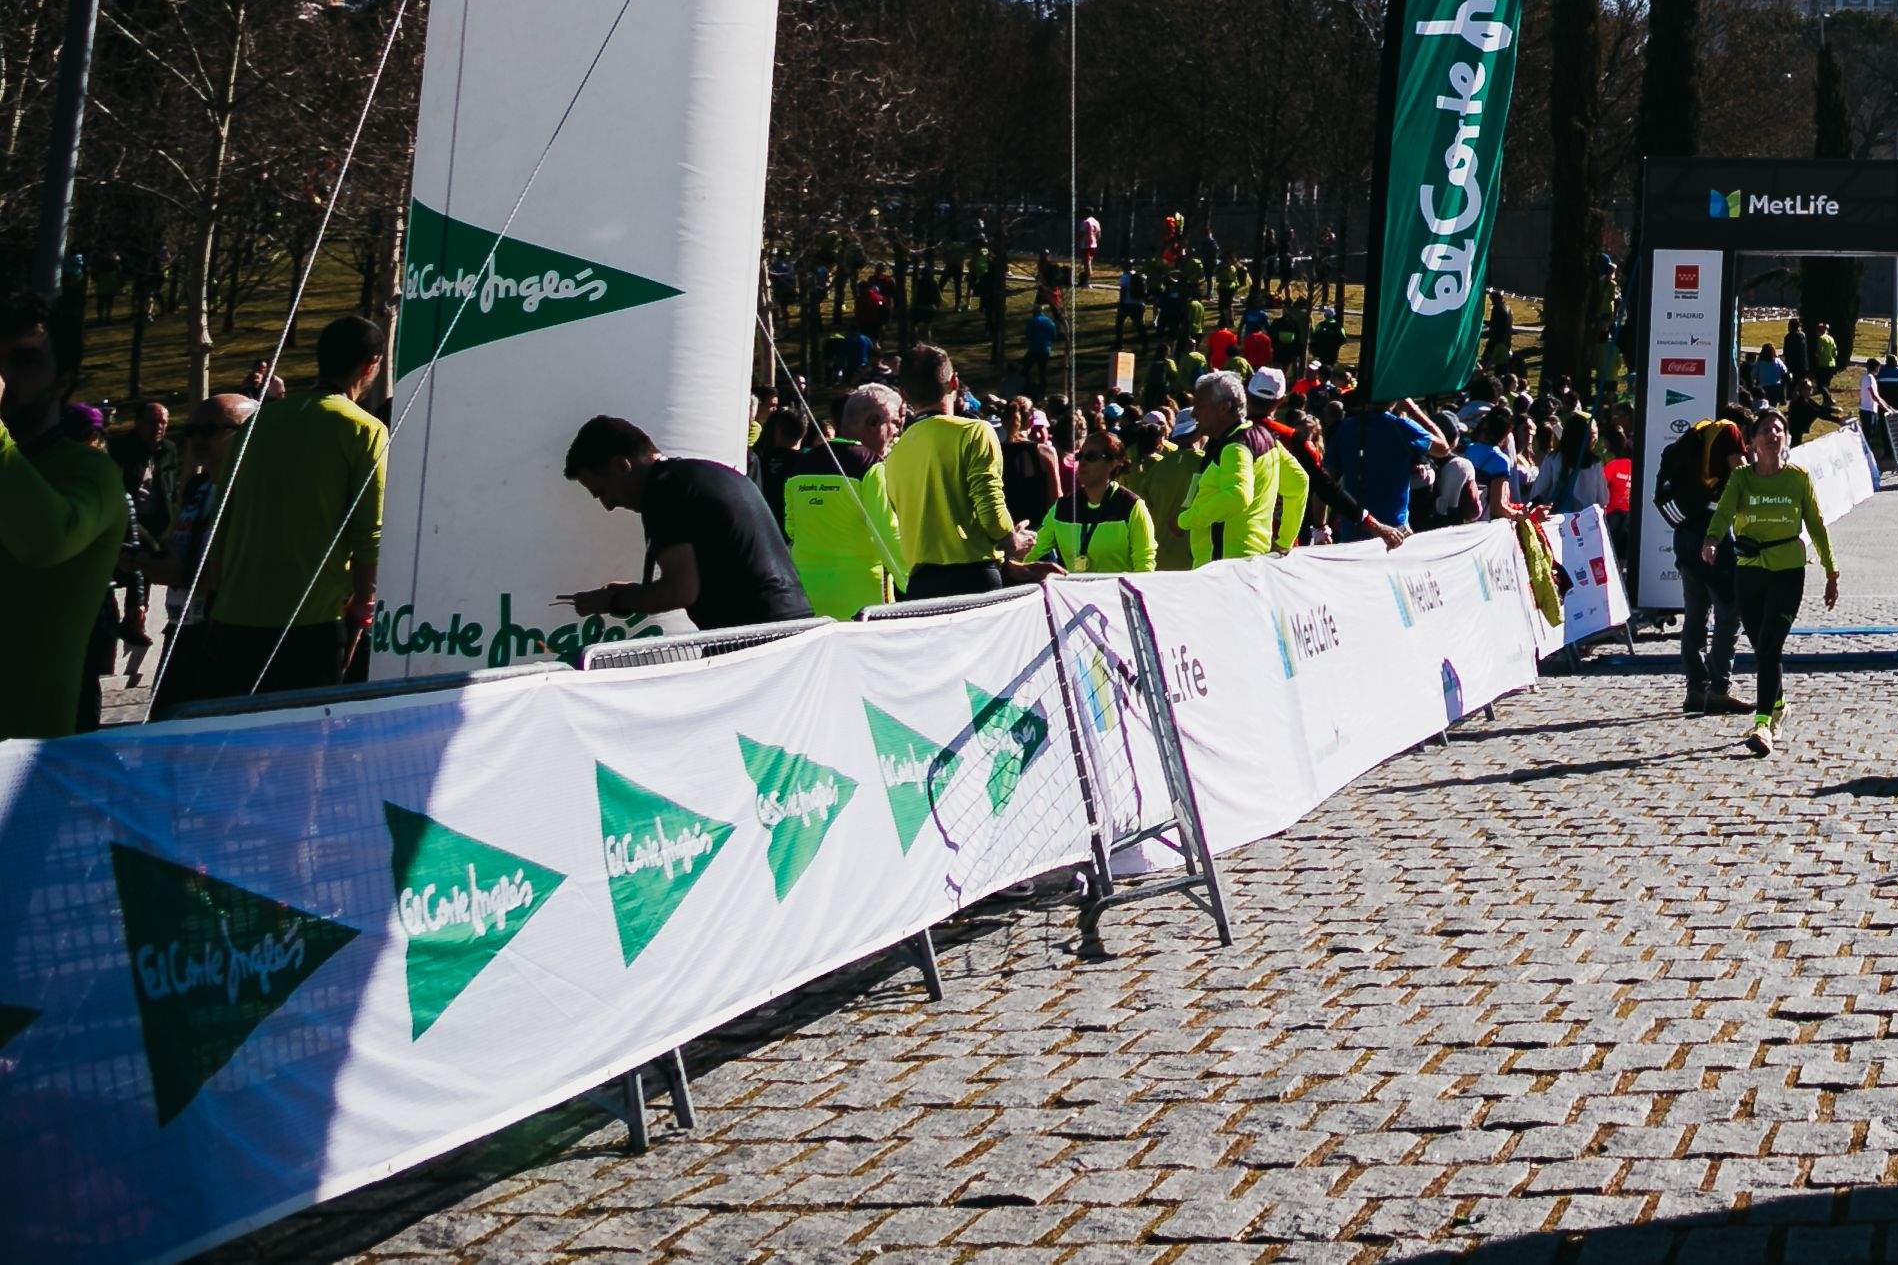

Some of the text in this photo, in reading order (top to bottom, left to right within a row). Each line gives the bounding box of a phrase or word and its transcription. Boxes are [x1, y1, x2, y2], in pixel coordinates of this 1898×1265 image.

[1419, 61, 1486, 234] Corte
[1748, 194, 1840, 215] MetLife
[419, 263, 478, 300] Corte
[479, 252, 608, 314] Inglés
[1406, 238, 1476, 317] El
[1675, 312, 1705, 320] MADRID
[1761, 496, 1792, 505] MetLife
[391, 604, 483, 657] Corte
[400, 862, 534, 937] El Corte Inglés
